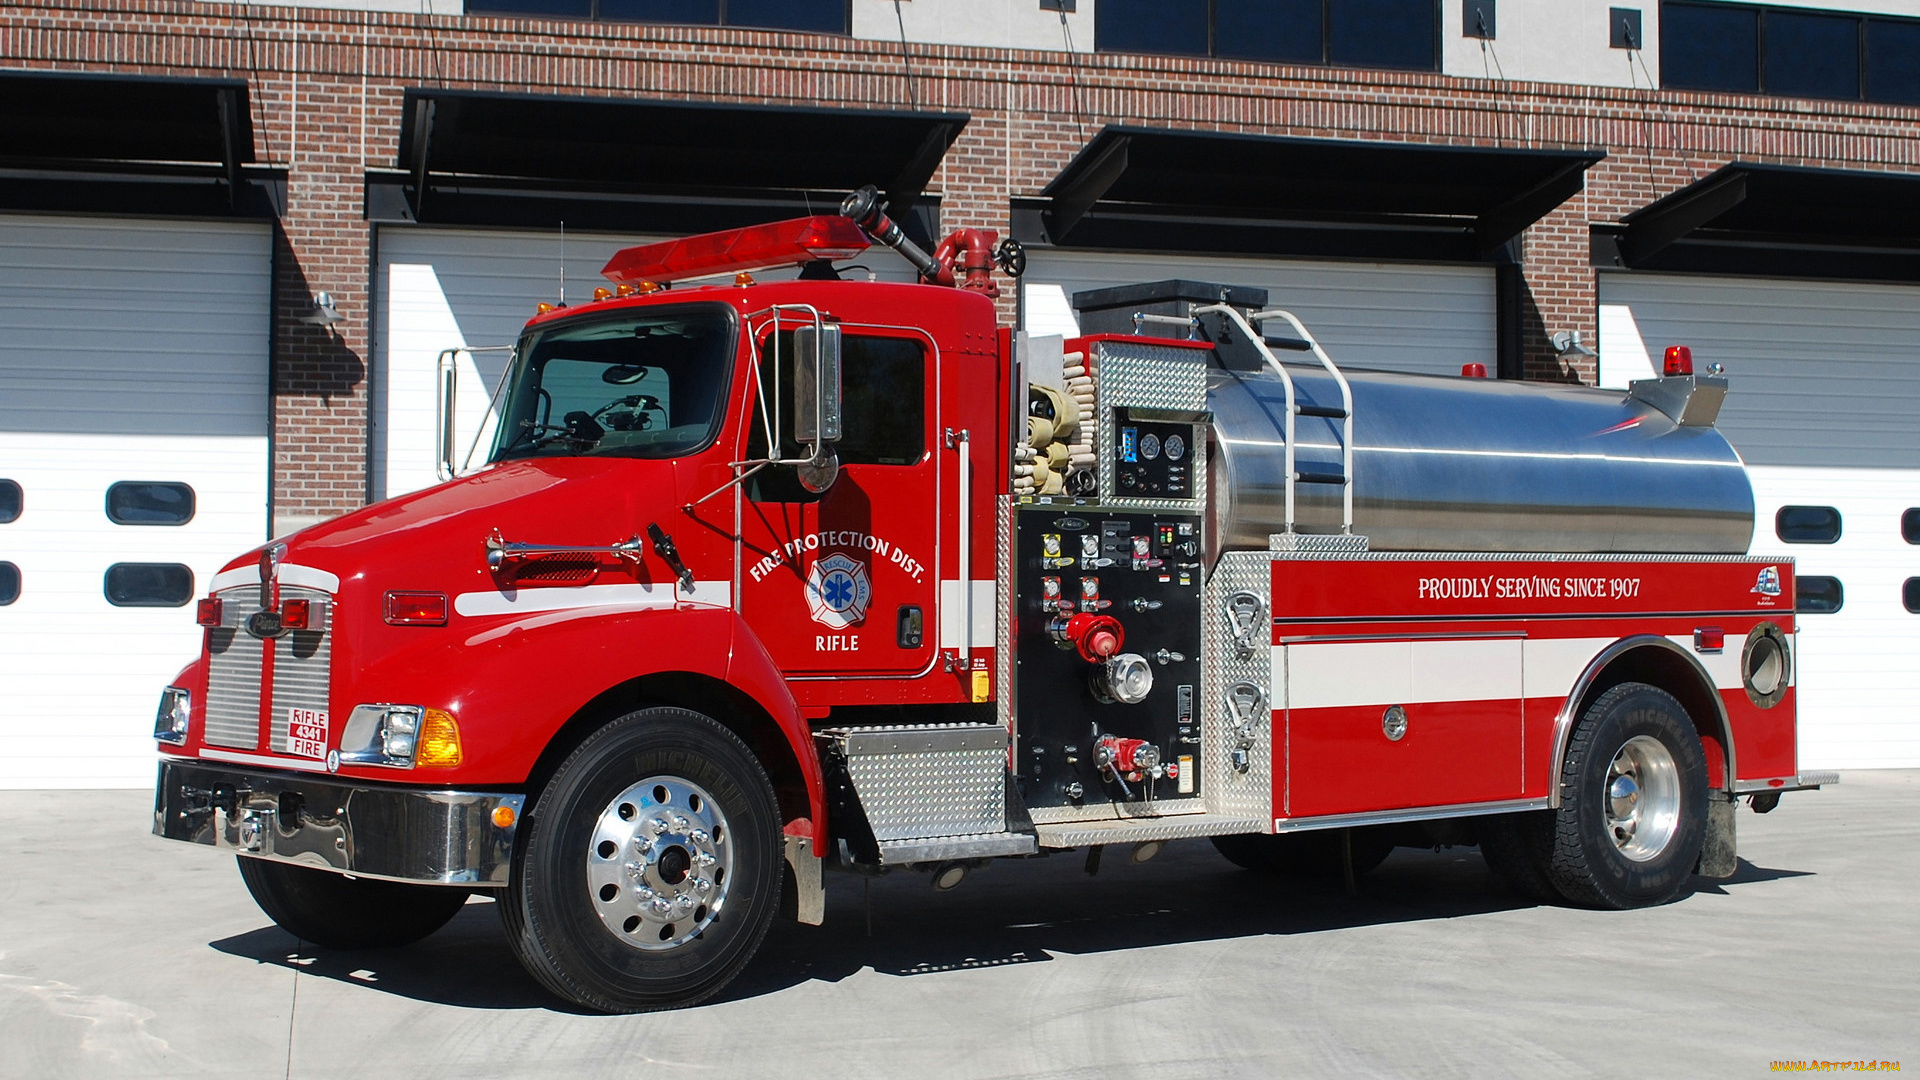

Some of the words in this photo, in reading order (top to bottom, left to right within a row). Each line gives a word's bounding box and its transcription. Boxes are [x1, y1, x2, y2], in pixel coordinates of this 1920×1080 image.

[749, 548, 784, 583] FIRE
[784, 530, 890, 558] PROTECTION
[890, 547, 925, 584] DIST.
[824, 560, 853, 571] RESCUE
[1418, 574, 1494, 600] PROUDLY
[1495, 575, 1561, 599] SERVING
[1564, 577, 1607, 598] SINCE
[1608, 577, 1641, 600] 1907
[815, 635, 859, 651] RIFLE
[293, 709, 325, 727] RIFLE
[296, 725, 321, 741] 4341
[294, 740, 321, 757] FIRE
